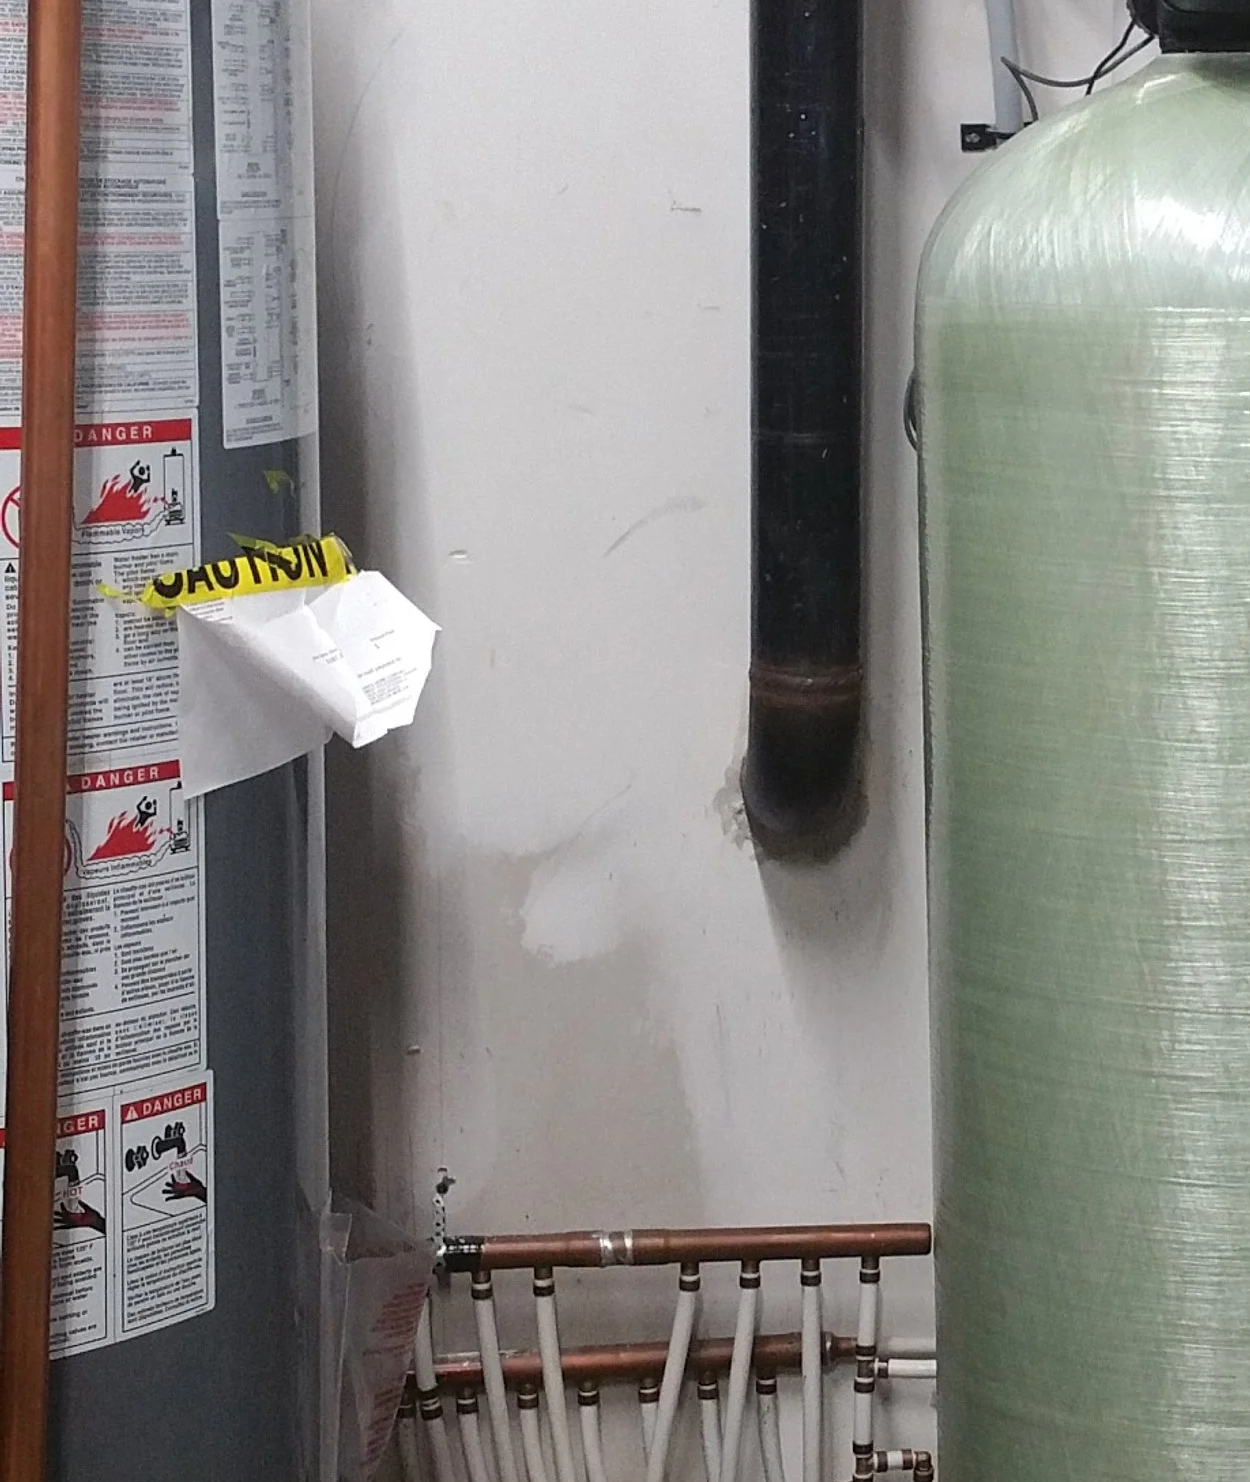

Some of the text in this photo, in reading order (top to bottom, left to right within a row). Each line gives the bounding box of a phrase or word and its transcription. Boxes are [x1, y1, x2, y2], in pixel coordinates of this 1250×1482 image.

[74, 425, 152, 442] DANGER
[81, 766, 158, 789] DANGER
[143, 1088, 202, 1115] DANGER
[57, 1115, 98, 1134] GER
[63, 1187, 82, 1198] HOT
